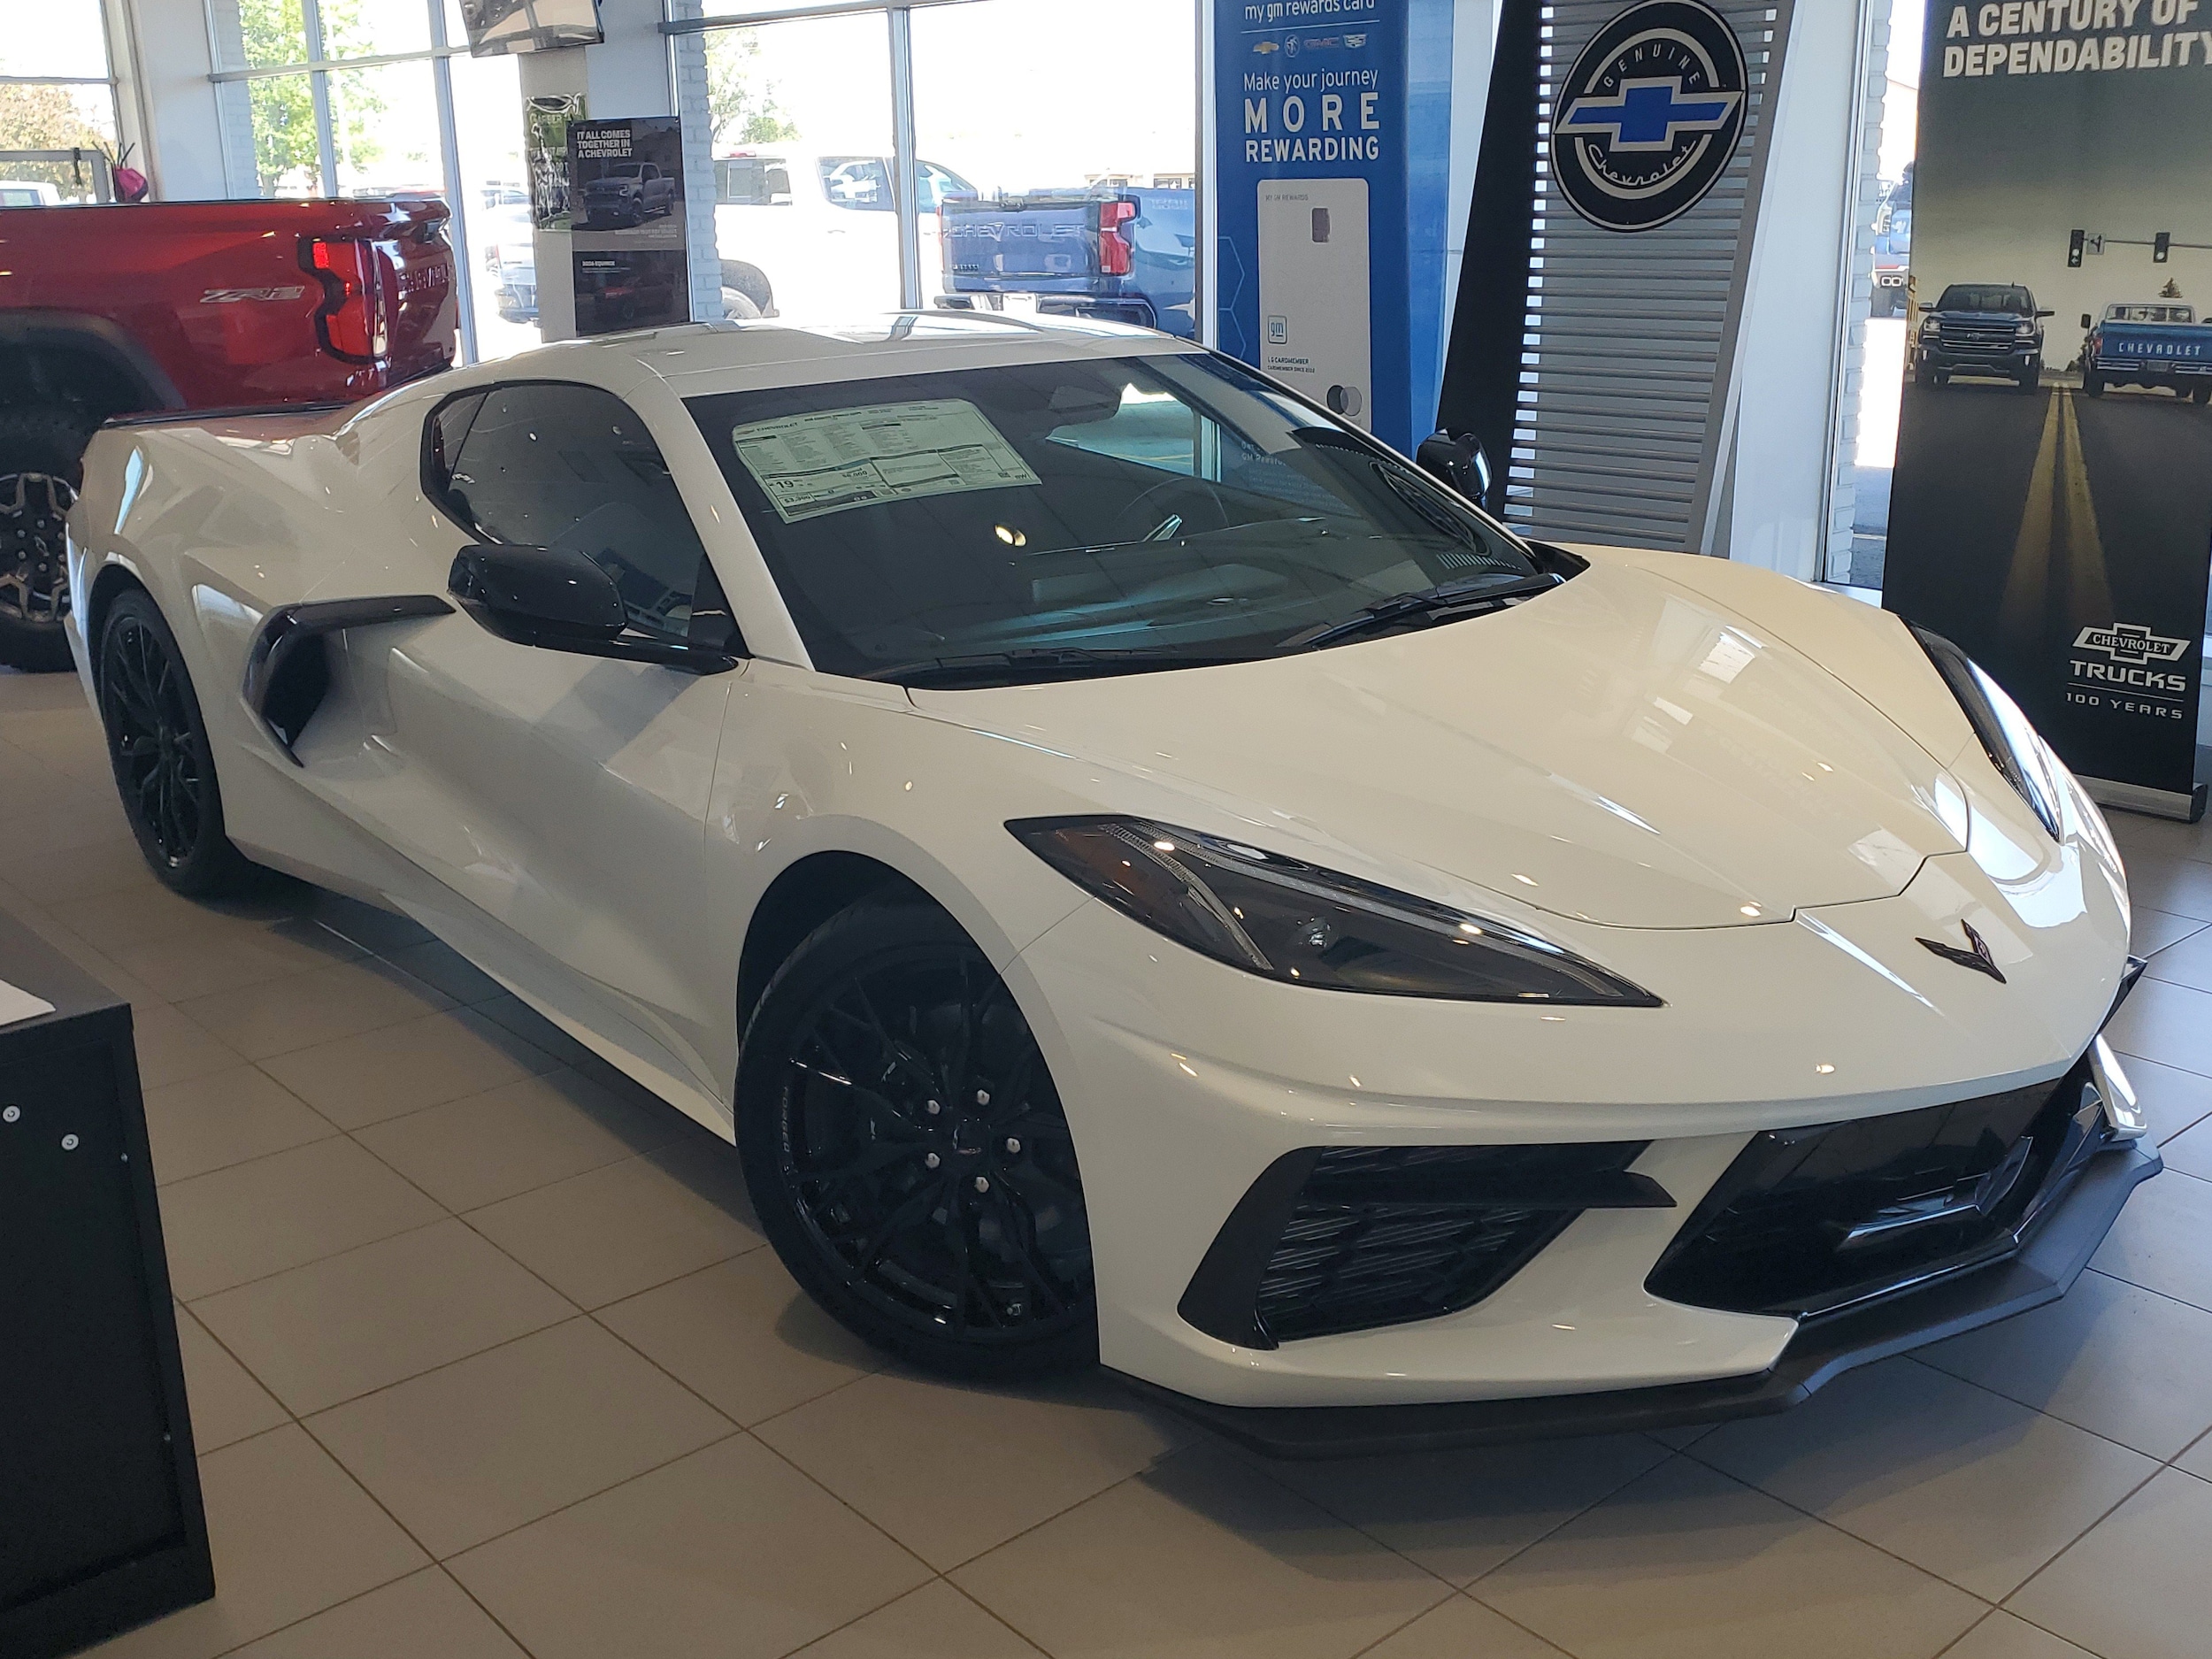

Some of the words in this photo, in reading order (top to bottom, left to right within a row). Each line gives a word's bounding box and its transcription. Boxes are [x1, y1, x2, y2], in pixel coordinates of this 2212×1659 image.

[1245, 5, 1263, 23] my
[1267, 4, 1284, 23] gm
[1286, 0, 1340, 17] rewards
[1947, 5, 1970, 38] A
[1978, 0, 2139, 37] CENTURY
[2151, 0, 2199, 27] OF
[1603, 43, 1701, 88] GENUINE
[1943, 31, 2212, 79] DEPENDABILITY
[1244, 72, 1279, 92] Make
[1283, 73, 1317, 94] your
[1320, 68, 1379, 93] journey
[1244, 92, 1380, 134] MORE
[577, 131, 585, 141] IT
[585, 130, 601, 140] ALL
[601, 129, 631, 139] COMES
[577, 140, 620, 150] TOGETHER
[620, 139, 631, 148] IN
[578, 150, 585, 158] A
[585, 148, 633, 157] CHEVROLET
[1245, 136, 1379, 163] REWARDING
[1588, 140, 1696, 187] Chevrolet
[952, 222, 1086, 239] CHEVROLET
[200, 285, 305, 303] ZR2
[2118, 342, 2201, 356] CHEVROLET
[2093, 634, 2170, 654] CHEVROLET
[2070, 659, 2187, 692] TRUCKS
[2066, 692, 2100, 706] 100
[2109, 699, 2184, 719] YEARS
